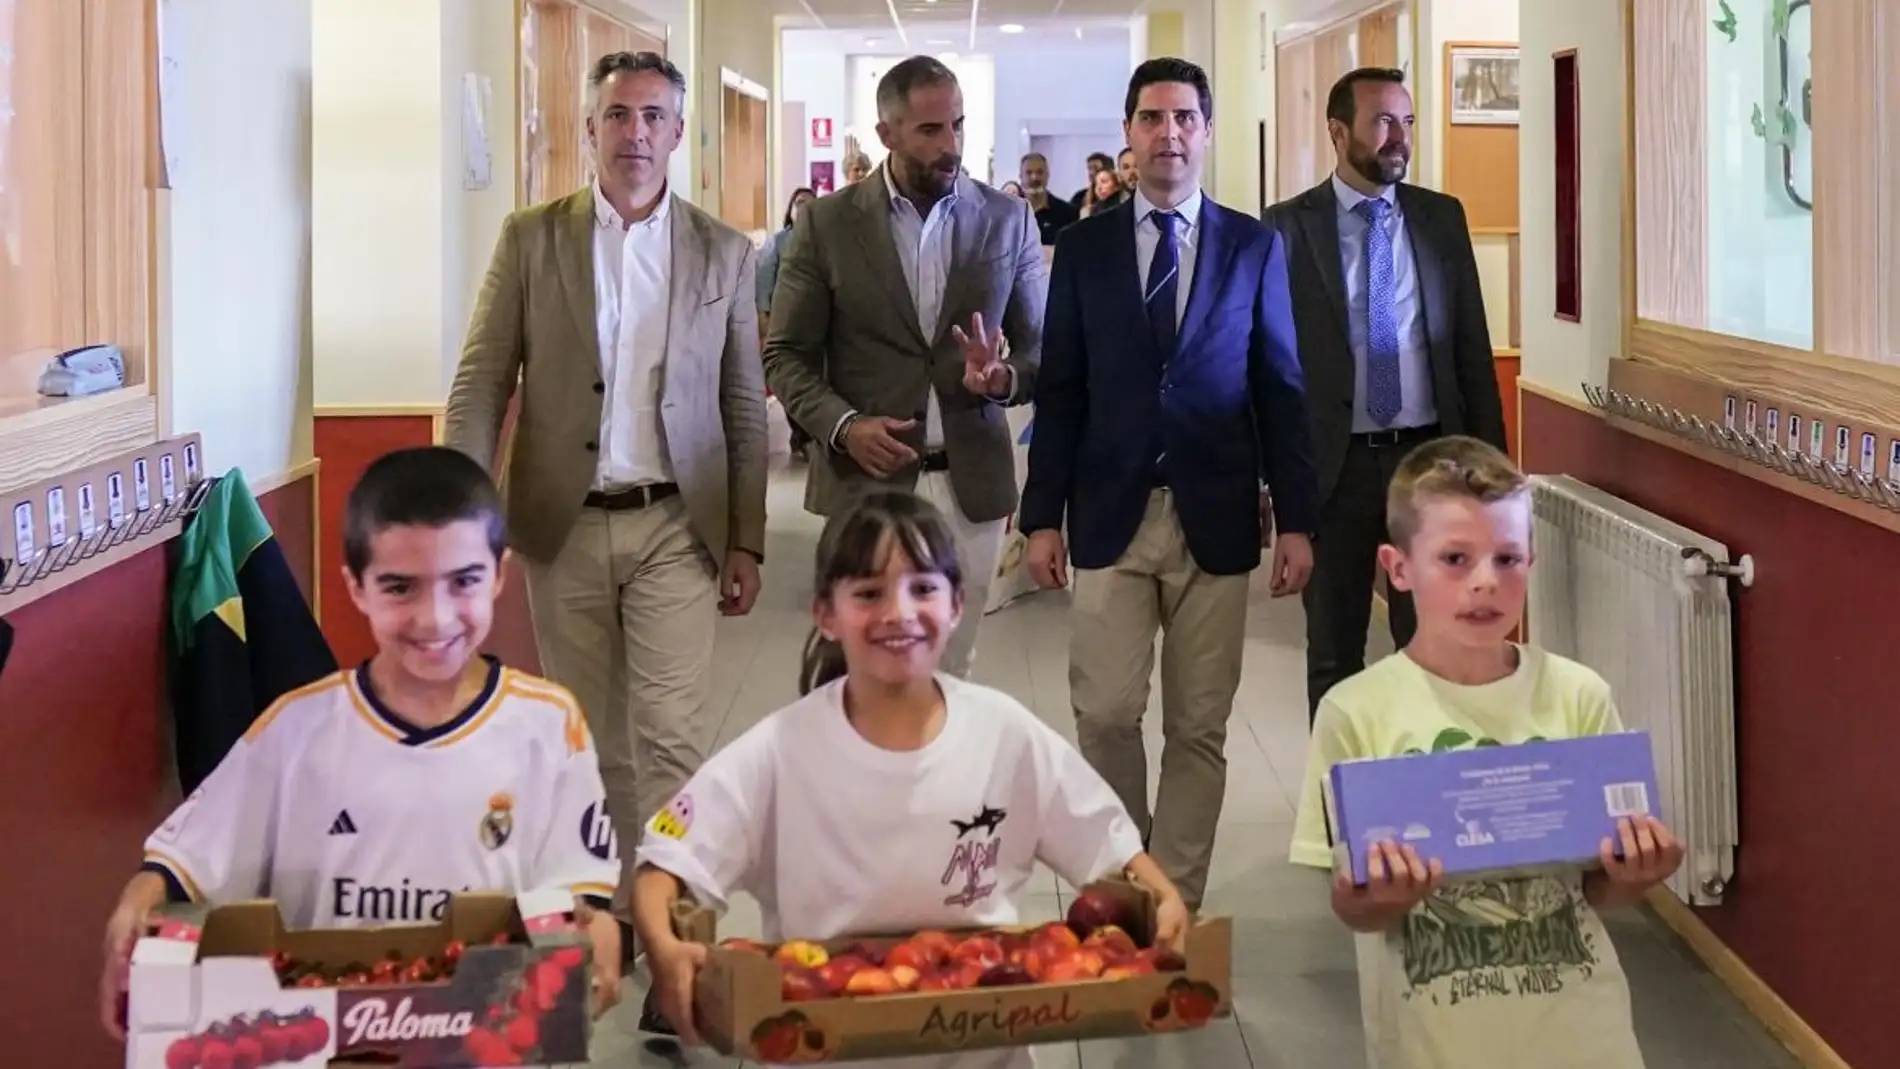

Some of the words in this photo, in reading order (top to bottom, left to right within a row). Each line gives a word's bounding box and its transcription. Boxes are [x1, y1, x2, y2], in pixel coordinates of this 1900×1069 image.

[333, 877, 469, 921] Emira
[343, 997, 474, 1046] Paloma
[919, 991, 1081, 1040] Agripal
